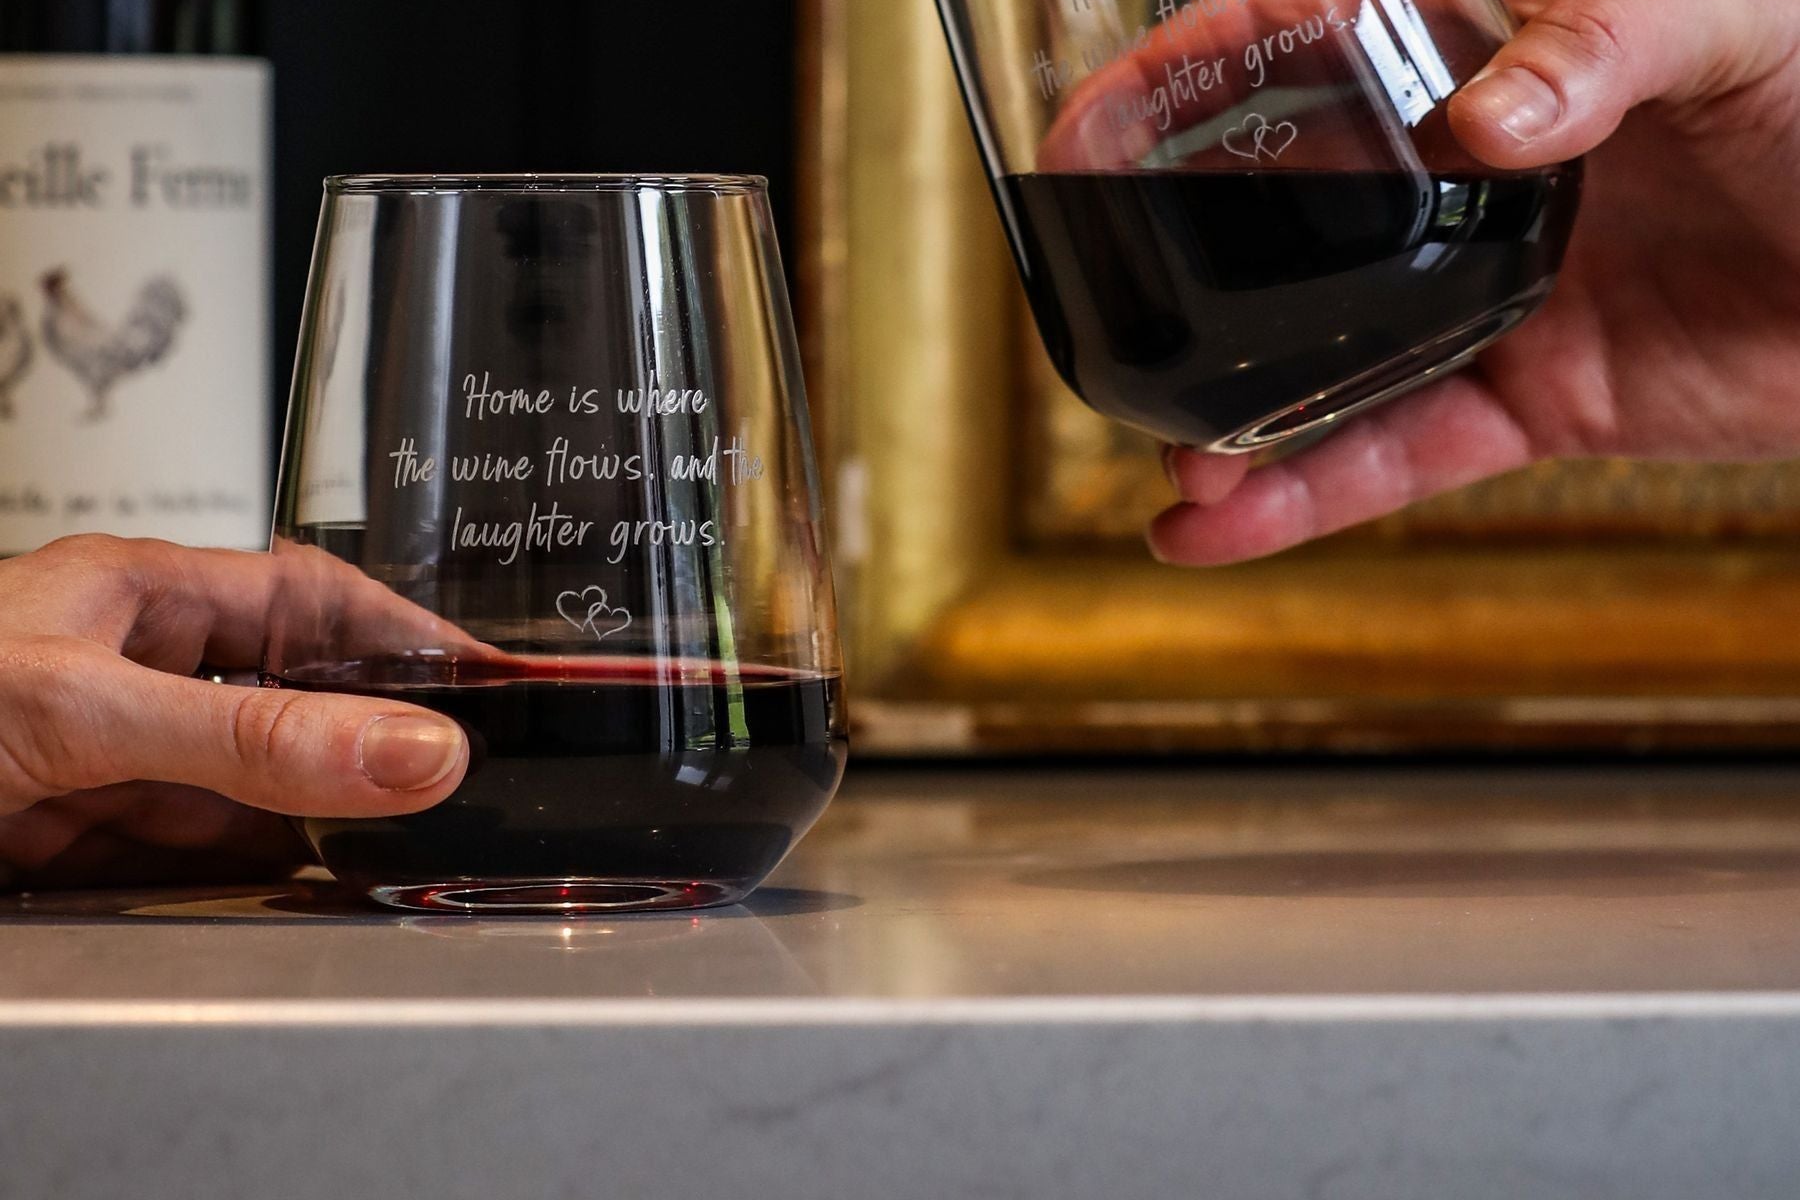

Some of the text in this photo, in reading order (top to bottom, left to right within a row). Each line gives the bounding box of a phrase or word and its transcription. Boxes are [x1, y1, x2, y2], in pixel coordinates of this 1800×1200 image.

[1244, 5, 1357, 88] grows.
[463, 369, 709, 421] Home is where
[389, 437, 437, 489] the
[451, 451, 535, 483] wine
[669, 435, 719, 487] and
[722, 435, 765, 487] the
[451, 501, 727, 566] laughter grows.
